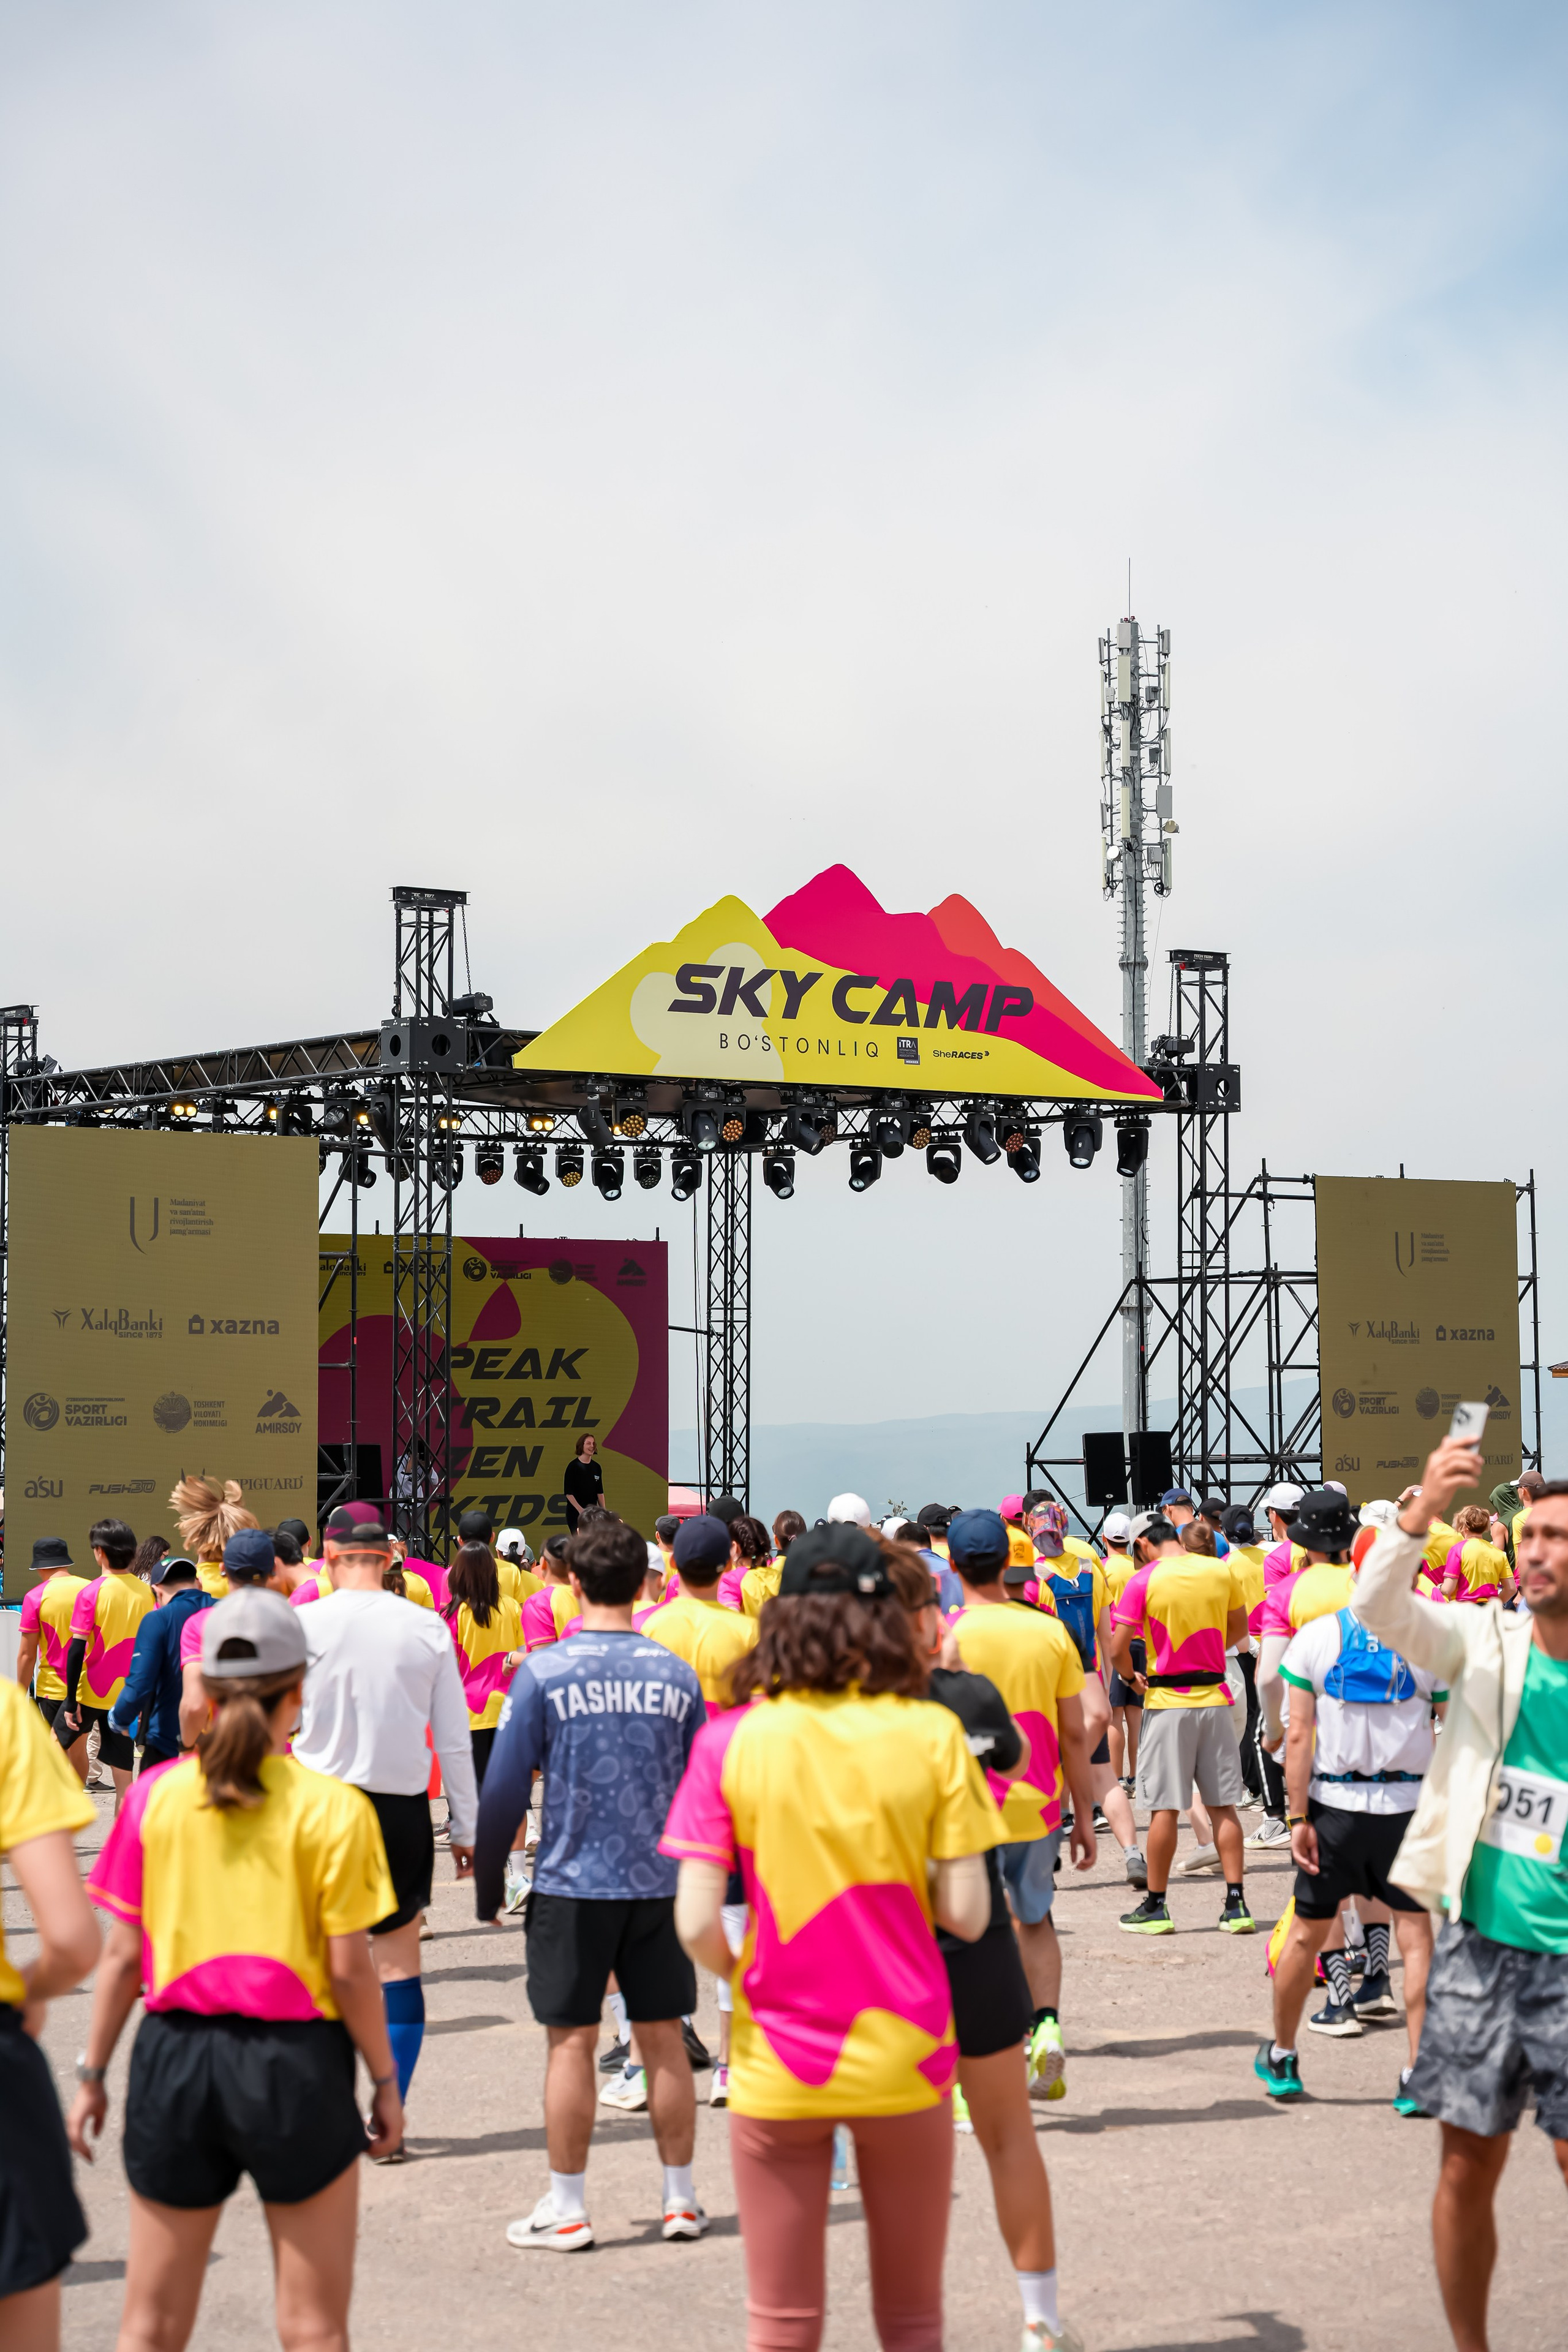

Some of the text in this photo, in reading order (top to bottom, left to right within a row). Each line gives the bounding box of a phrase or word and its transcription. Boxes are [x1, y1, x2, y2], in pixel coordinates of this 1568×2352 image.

[667, 963, 1034, 1032] SKY CAMP
[933, 1050, 984, 1060] SheRACES
[170, 1199, 206, 1208] Madaniyat
[170, 1218, 214, 1226] rivojlantirish
[209, 1319, 280, 1335] xazna
[1450, 1329, 1495, 1340] xazna
[431, 1348, 589, 1379] PEAK
[1359, 1396, 1386, 1405] SPORT
[65, 1404, 108, 1414] SPORT
[435, 1396, 600, 1429] TRAIL
[65, 1416, 127, 1426] VAZIRLIGI
[1488, 1411, 1511, 1420] MIRSOY
[255, 1422, 302, 1434] AMIRSOY
[437, 1446, 545, 1479] ZEN
[229, 1477, 303, 1491] PIGUARD
[548, 1680, 691, 1724] TASHKENT
